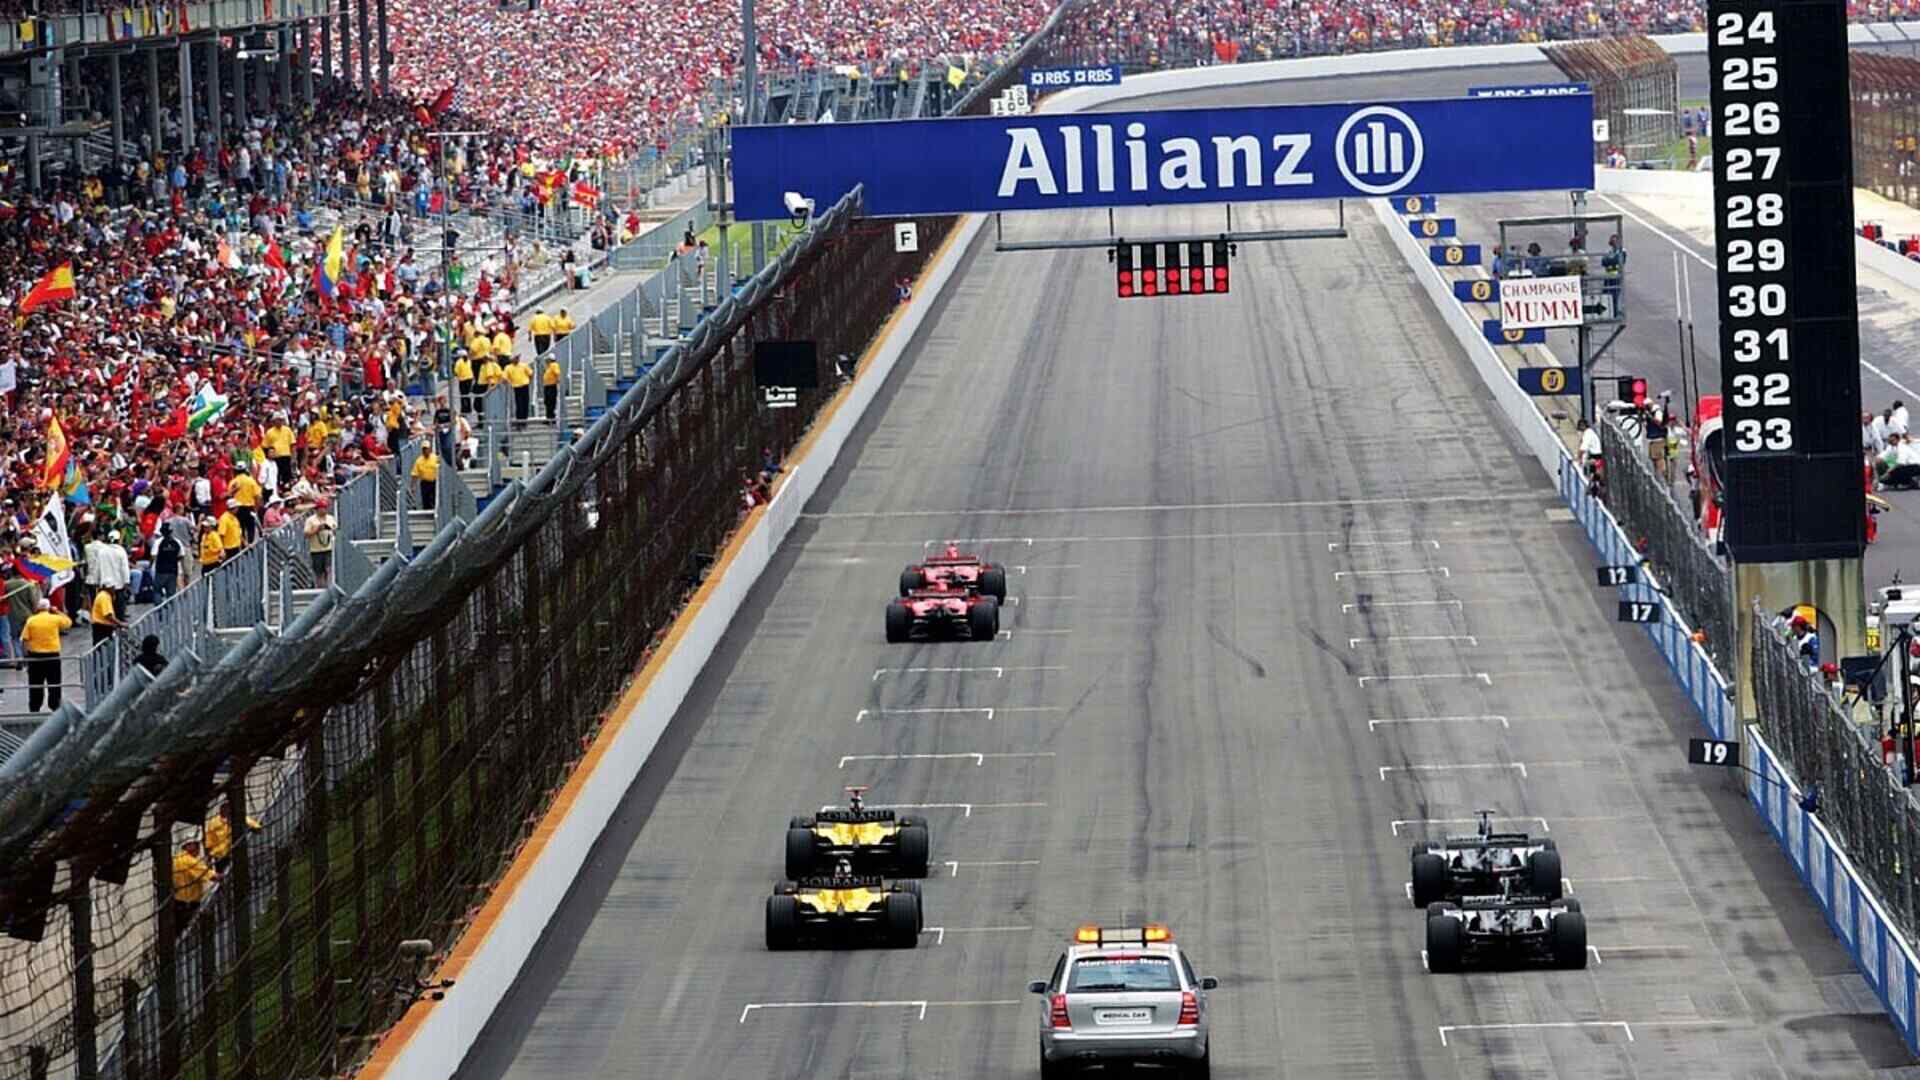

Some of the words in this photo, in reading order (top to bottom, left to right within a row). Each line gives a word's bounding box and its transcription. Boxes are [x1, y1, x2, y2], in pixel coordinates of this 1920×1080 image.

[1717, 11, 1777, 46] 24
[1045, 70, 1071, 85] RBS
[1087, 68, 1113, 83] RBS
[1722, 57, 1778, 91] 25
[1724, 101, 1780, 136] 26
[997, 122, 1314, 197] Allianz
[1726, 147, 1781, 181] 27
[1727, 193, 1784, 229] 28
[901, 231, 912, 247] F
[1727, 238, 1785, 273] 29
[1502, 282, 1578, 297] CHAMPAGNE
[1729, 283, 1786, 317] 30
[1504, 300, 1579, 324] MUMM
[1734, 328, 1789, 362] 31
[1733, 373, 1791, 407] 32
[1735, 417, 1793, 452] 33
[1608, 568, 1628, 585] 12
[1631, 603, 1653, 621] 17
[1703, 742, 1728, 765] 19
